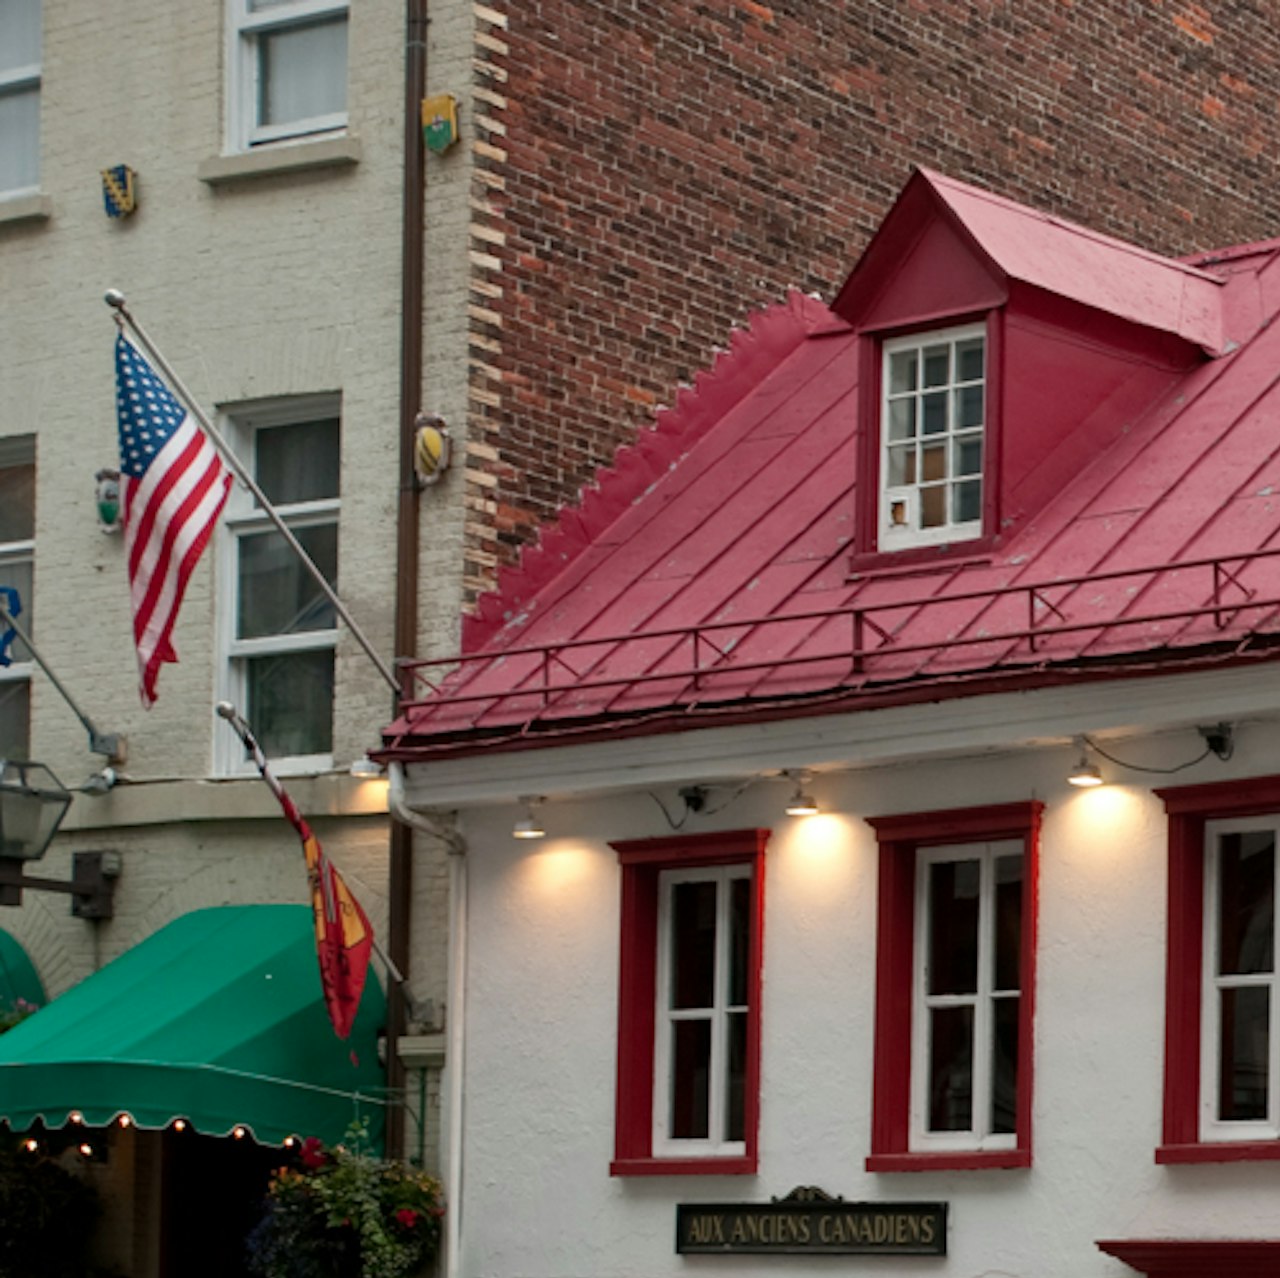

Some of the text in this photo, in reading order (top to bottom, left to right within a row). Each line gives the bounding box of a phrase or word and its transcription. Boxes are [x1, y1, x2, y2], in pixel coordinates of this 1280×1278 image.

[690, 1214, 934, 1243] AUX ANCIENS CANADIENS
